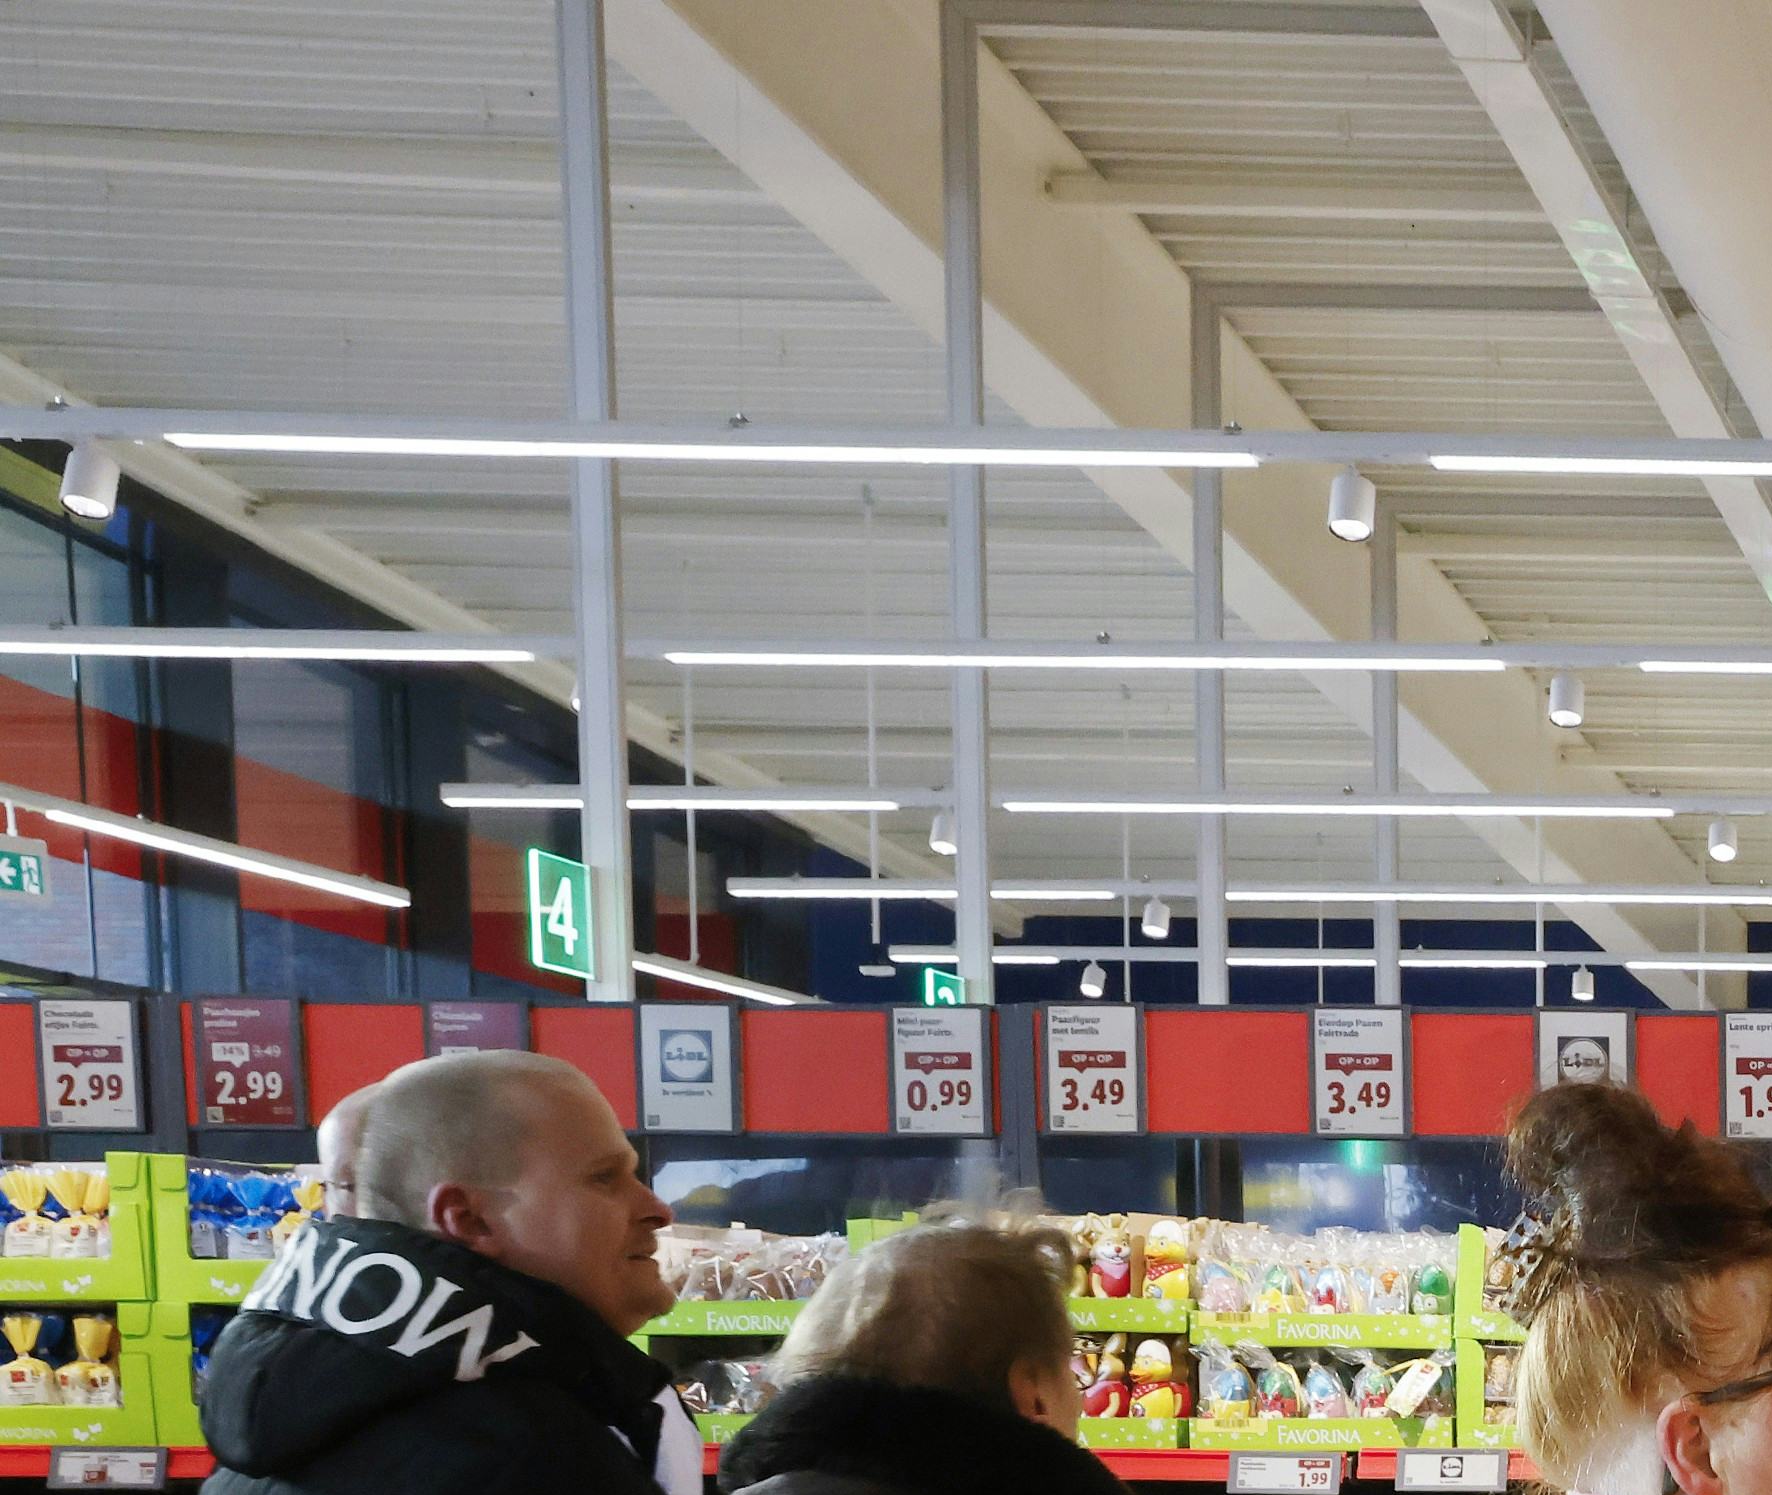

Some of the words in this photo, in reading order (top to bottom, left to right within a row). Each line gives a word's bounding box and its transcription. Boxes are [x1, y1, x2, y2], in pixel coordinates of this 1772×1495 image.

[548, 876, 578, 956] 4
[1729, 1023, 1754, 1031] Lente
[1749, 1061, 1764, 1070] OP
[57, 1074, 123, 1107] 2.99
[215, 1071, 283, 1105] 2.99
[907, 1080, 972, 1111] 0.99
[1061, 1078, 1125, 1111] 3.49
[1327, 1081, 1391, 1114] 3.49
[240, 1226, 541, 1382] NOW
[706, 1311, 791, 1331] FAVORINA
[1277, 1320, 1361, 1341] FAVORINA
[1278, 1426, 1361, 1445] FAVORINA
[1299, 1472, 1328, 1488] 1.99
